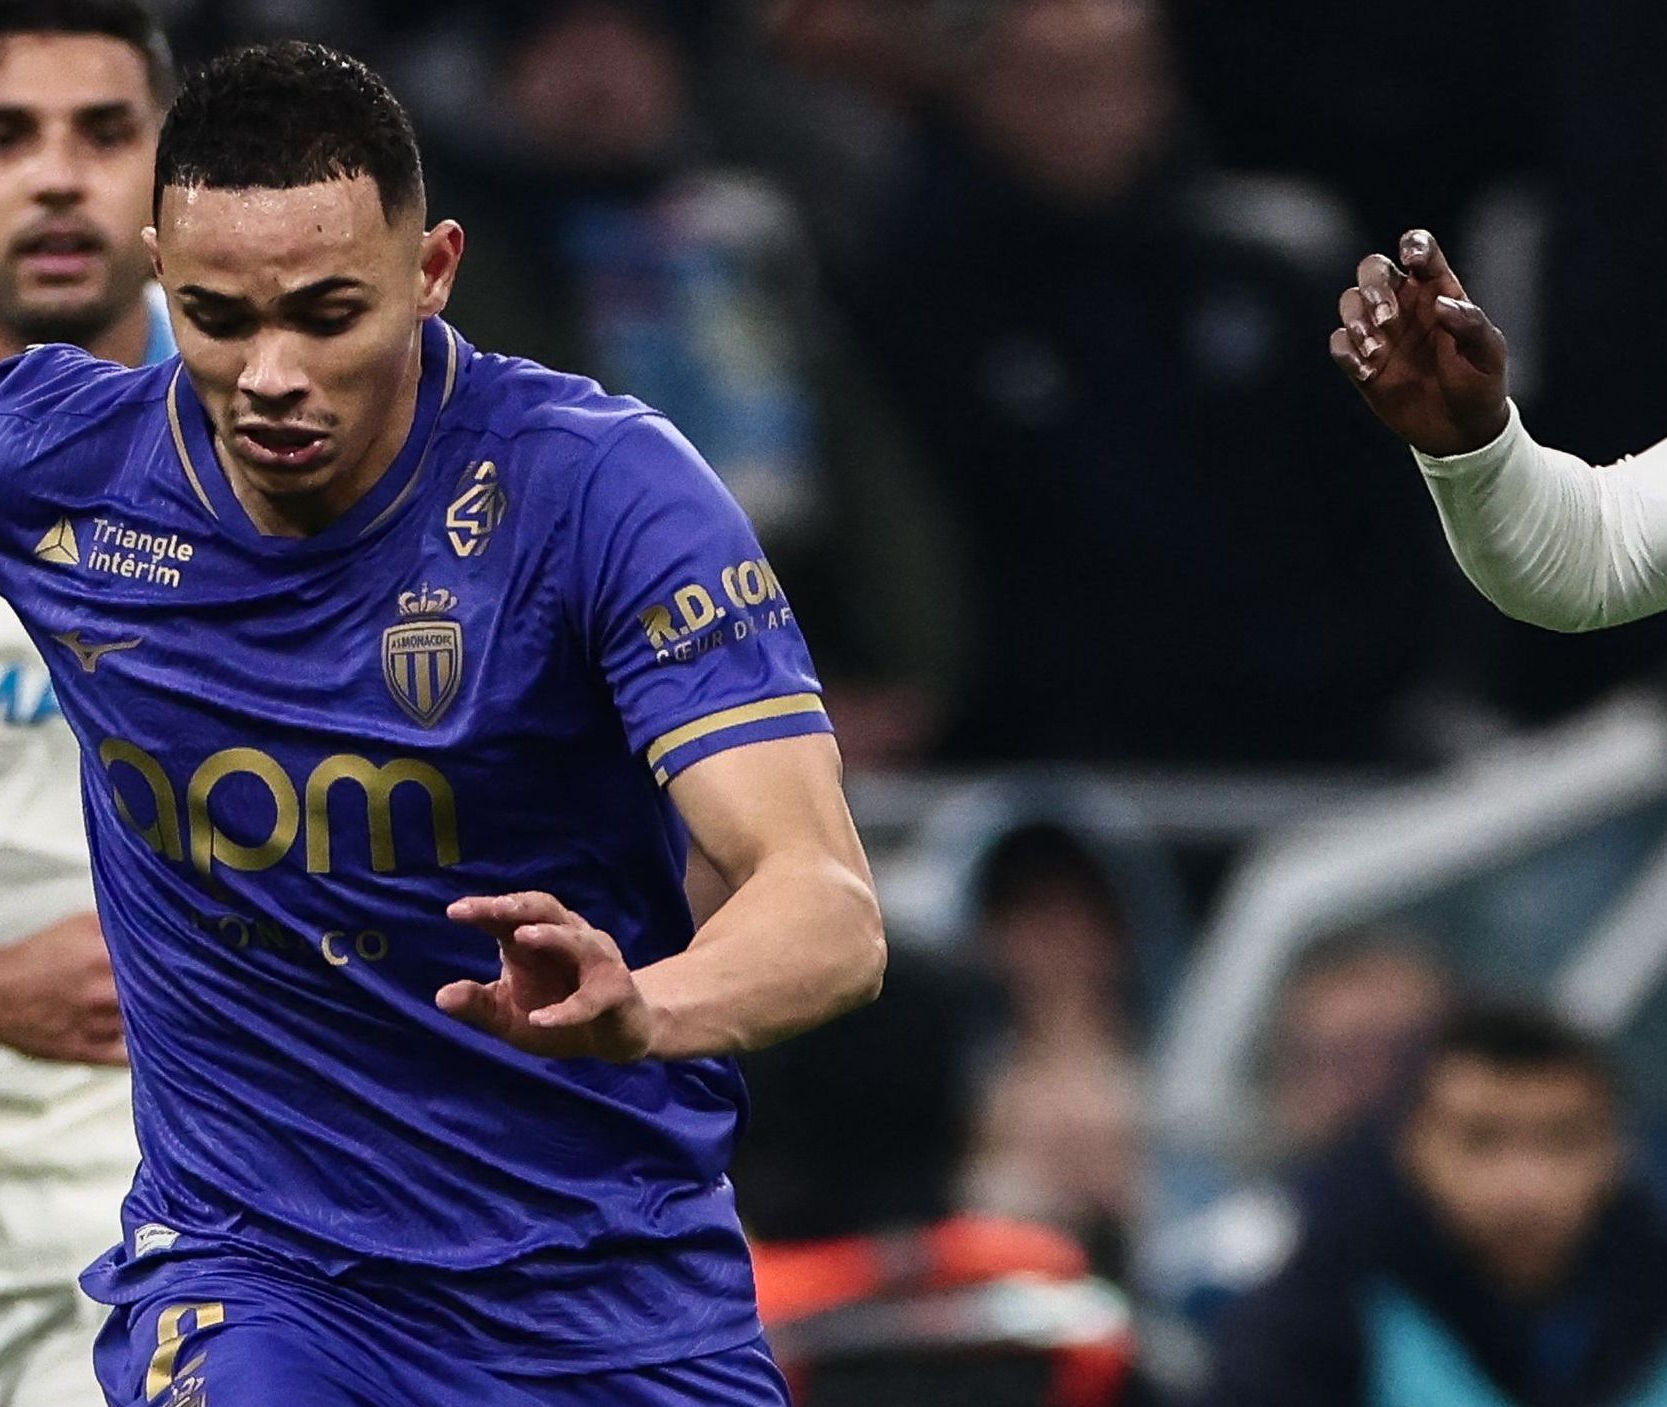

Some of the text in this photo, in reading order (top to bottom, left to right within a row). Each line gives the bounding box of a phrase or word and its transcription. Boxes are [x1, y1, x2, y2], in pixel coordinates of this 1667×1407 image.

[93, 517, 194, 561] Triangle
[637, 583, 726, 649] R.D.
[99, 738, 462, 877] apm
